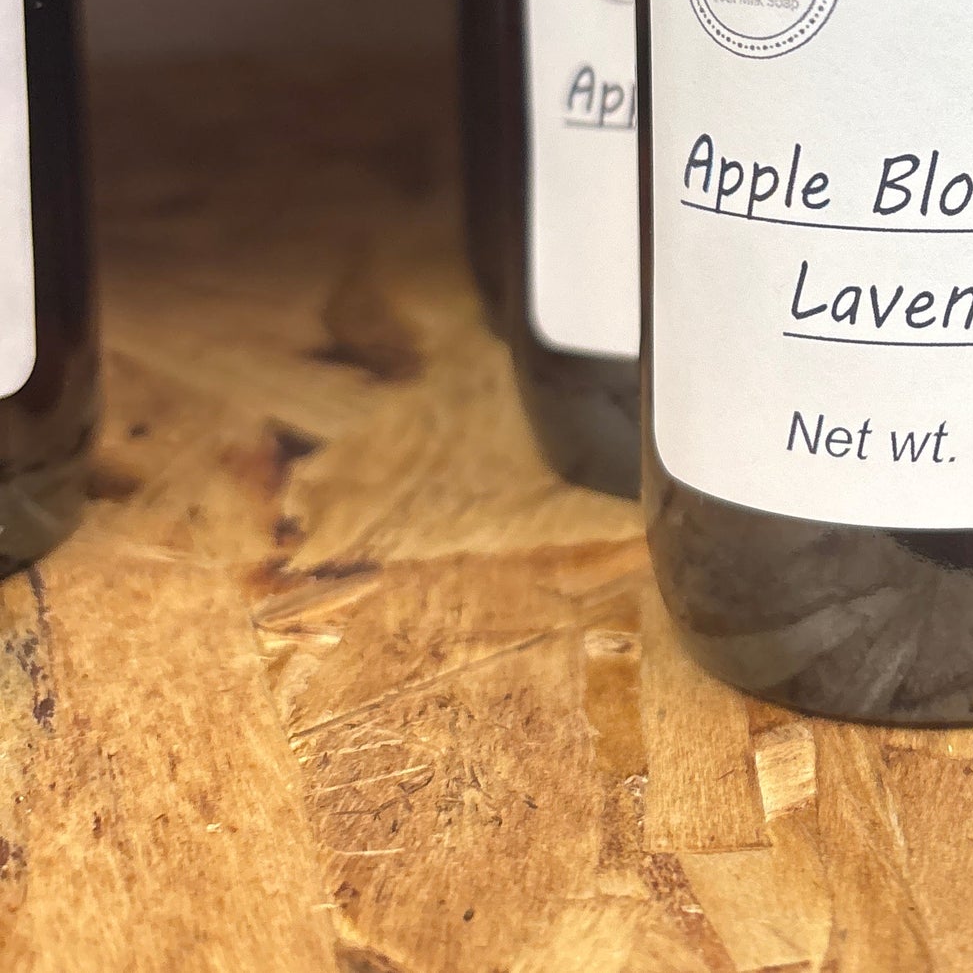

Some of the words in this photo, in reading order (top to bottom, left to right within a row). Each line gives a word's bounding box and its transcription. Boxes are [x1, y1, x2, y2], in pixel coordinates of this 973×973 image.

[683, 133, 831, 219] Apple
[787, 411, 872, 460] Net
[890, 420, 957, 463] wt.
